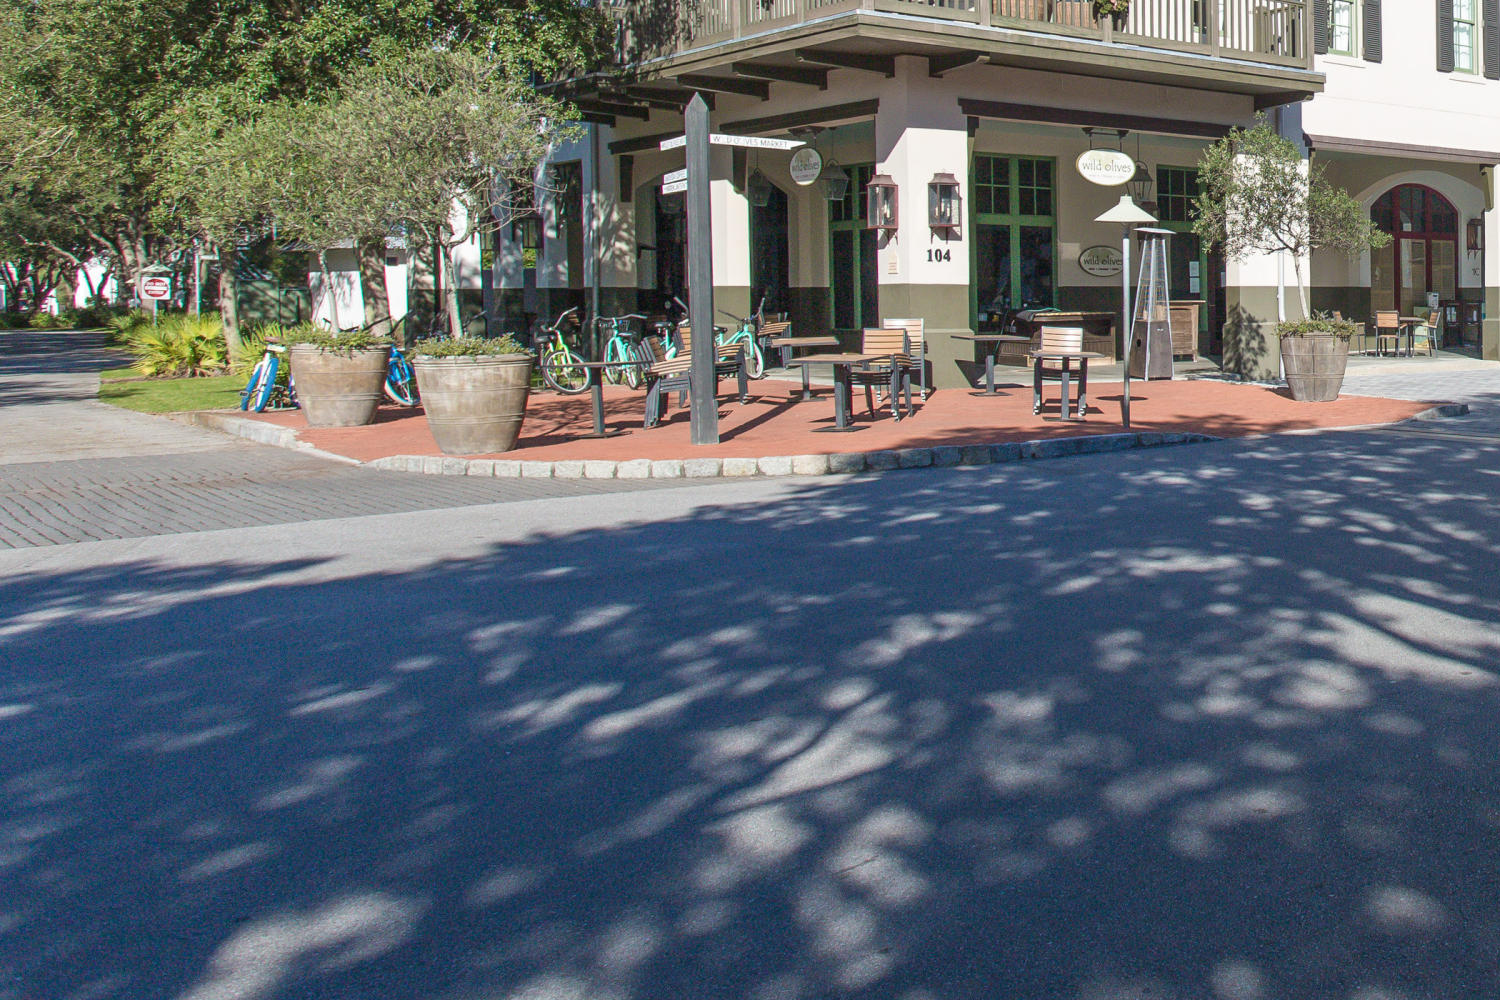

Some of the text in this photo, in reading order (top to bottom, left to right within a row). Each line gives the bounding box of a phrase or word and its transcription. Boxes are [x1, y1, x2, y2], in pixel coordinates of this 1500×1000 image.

[760, 139, 788, 148] MARKET
[1083, 160, 1131, 173] wild olives
[927, 249, 951, 262] 104
[1084, 255, 1099, 265] wild
